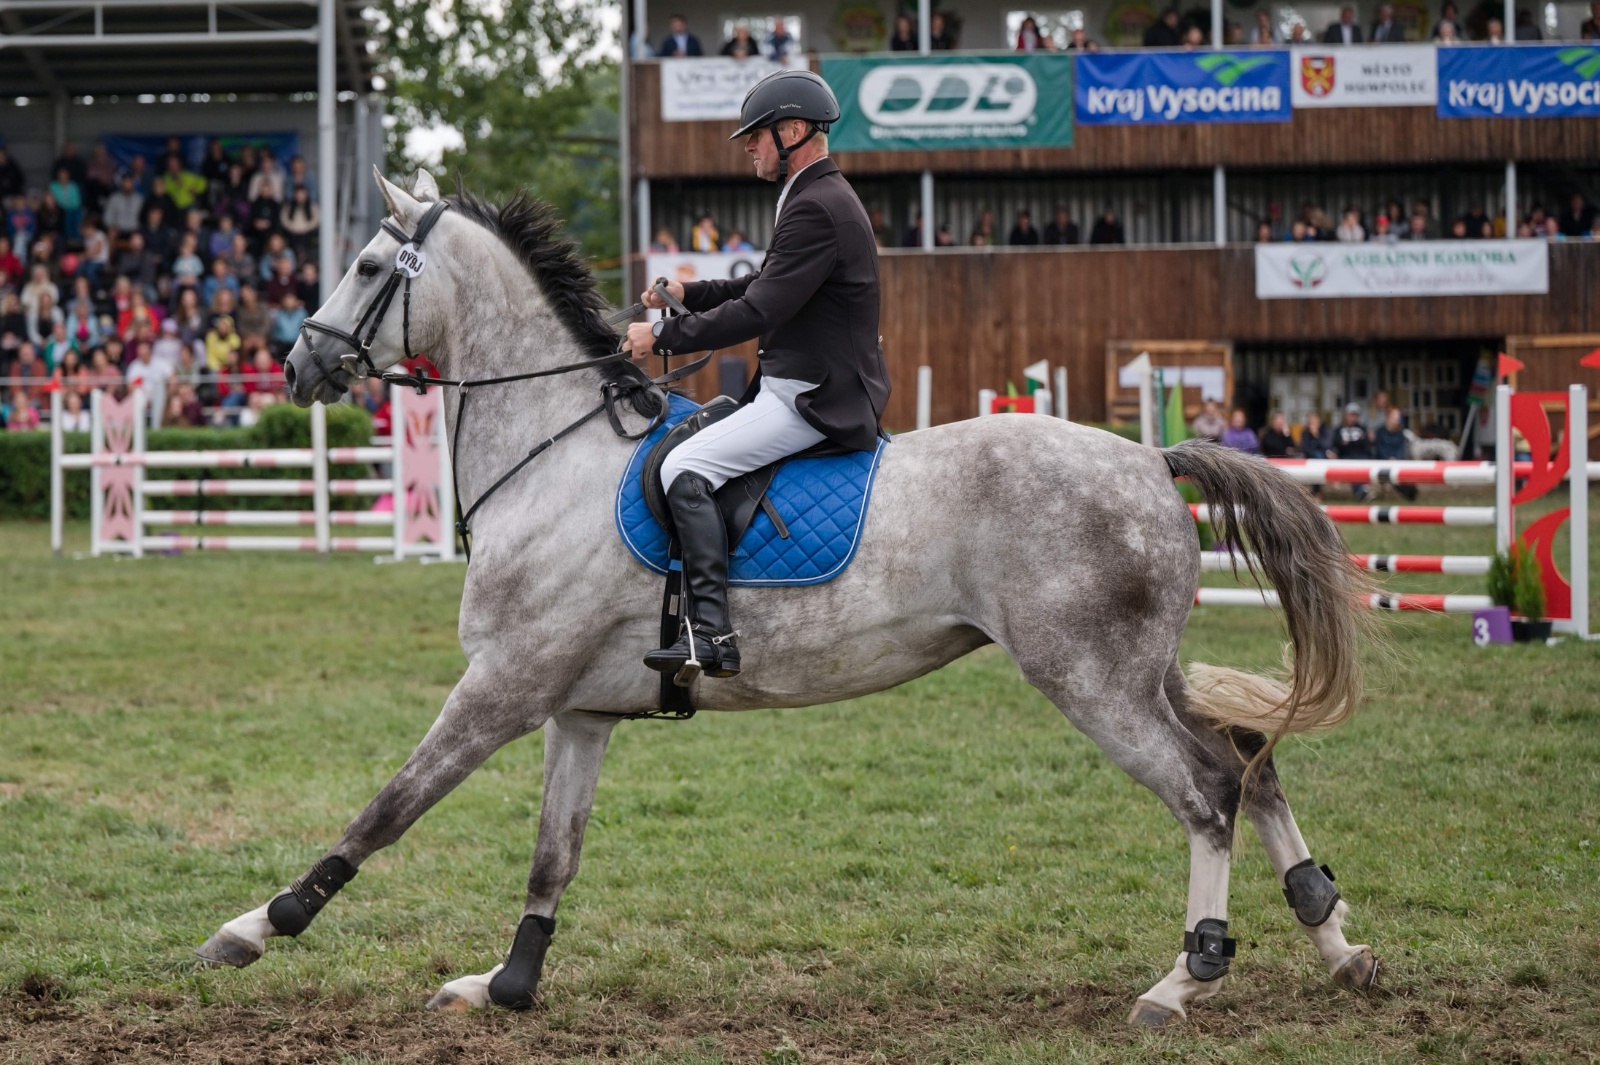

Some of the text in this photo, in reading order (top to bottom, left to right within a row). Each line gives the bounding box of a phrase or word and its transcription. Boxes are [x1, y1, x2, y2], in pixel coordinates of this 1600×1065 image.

[1088, 86, 1144, 121] Kraj
[1449, 79, 1504, 114] Kraj
[1474, 617, 1490, 647] 3
